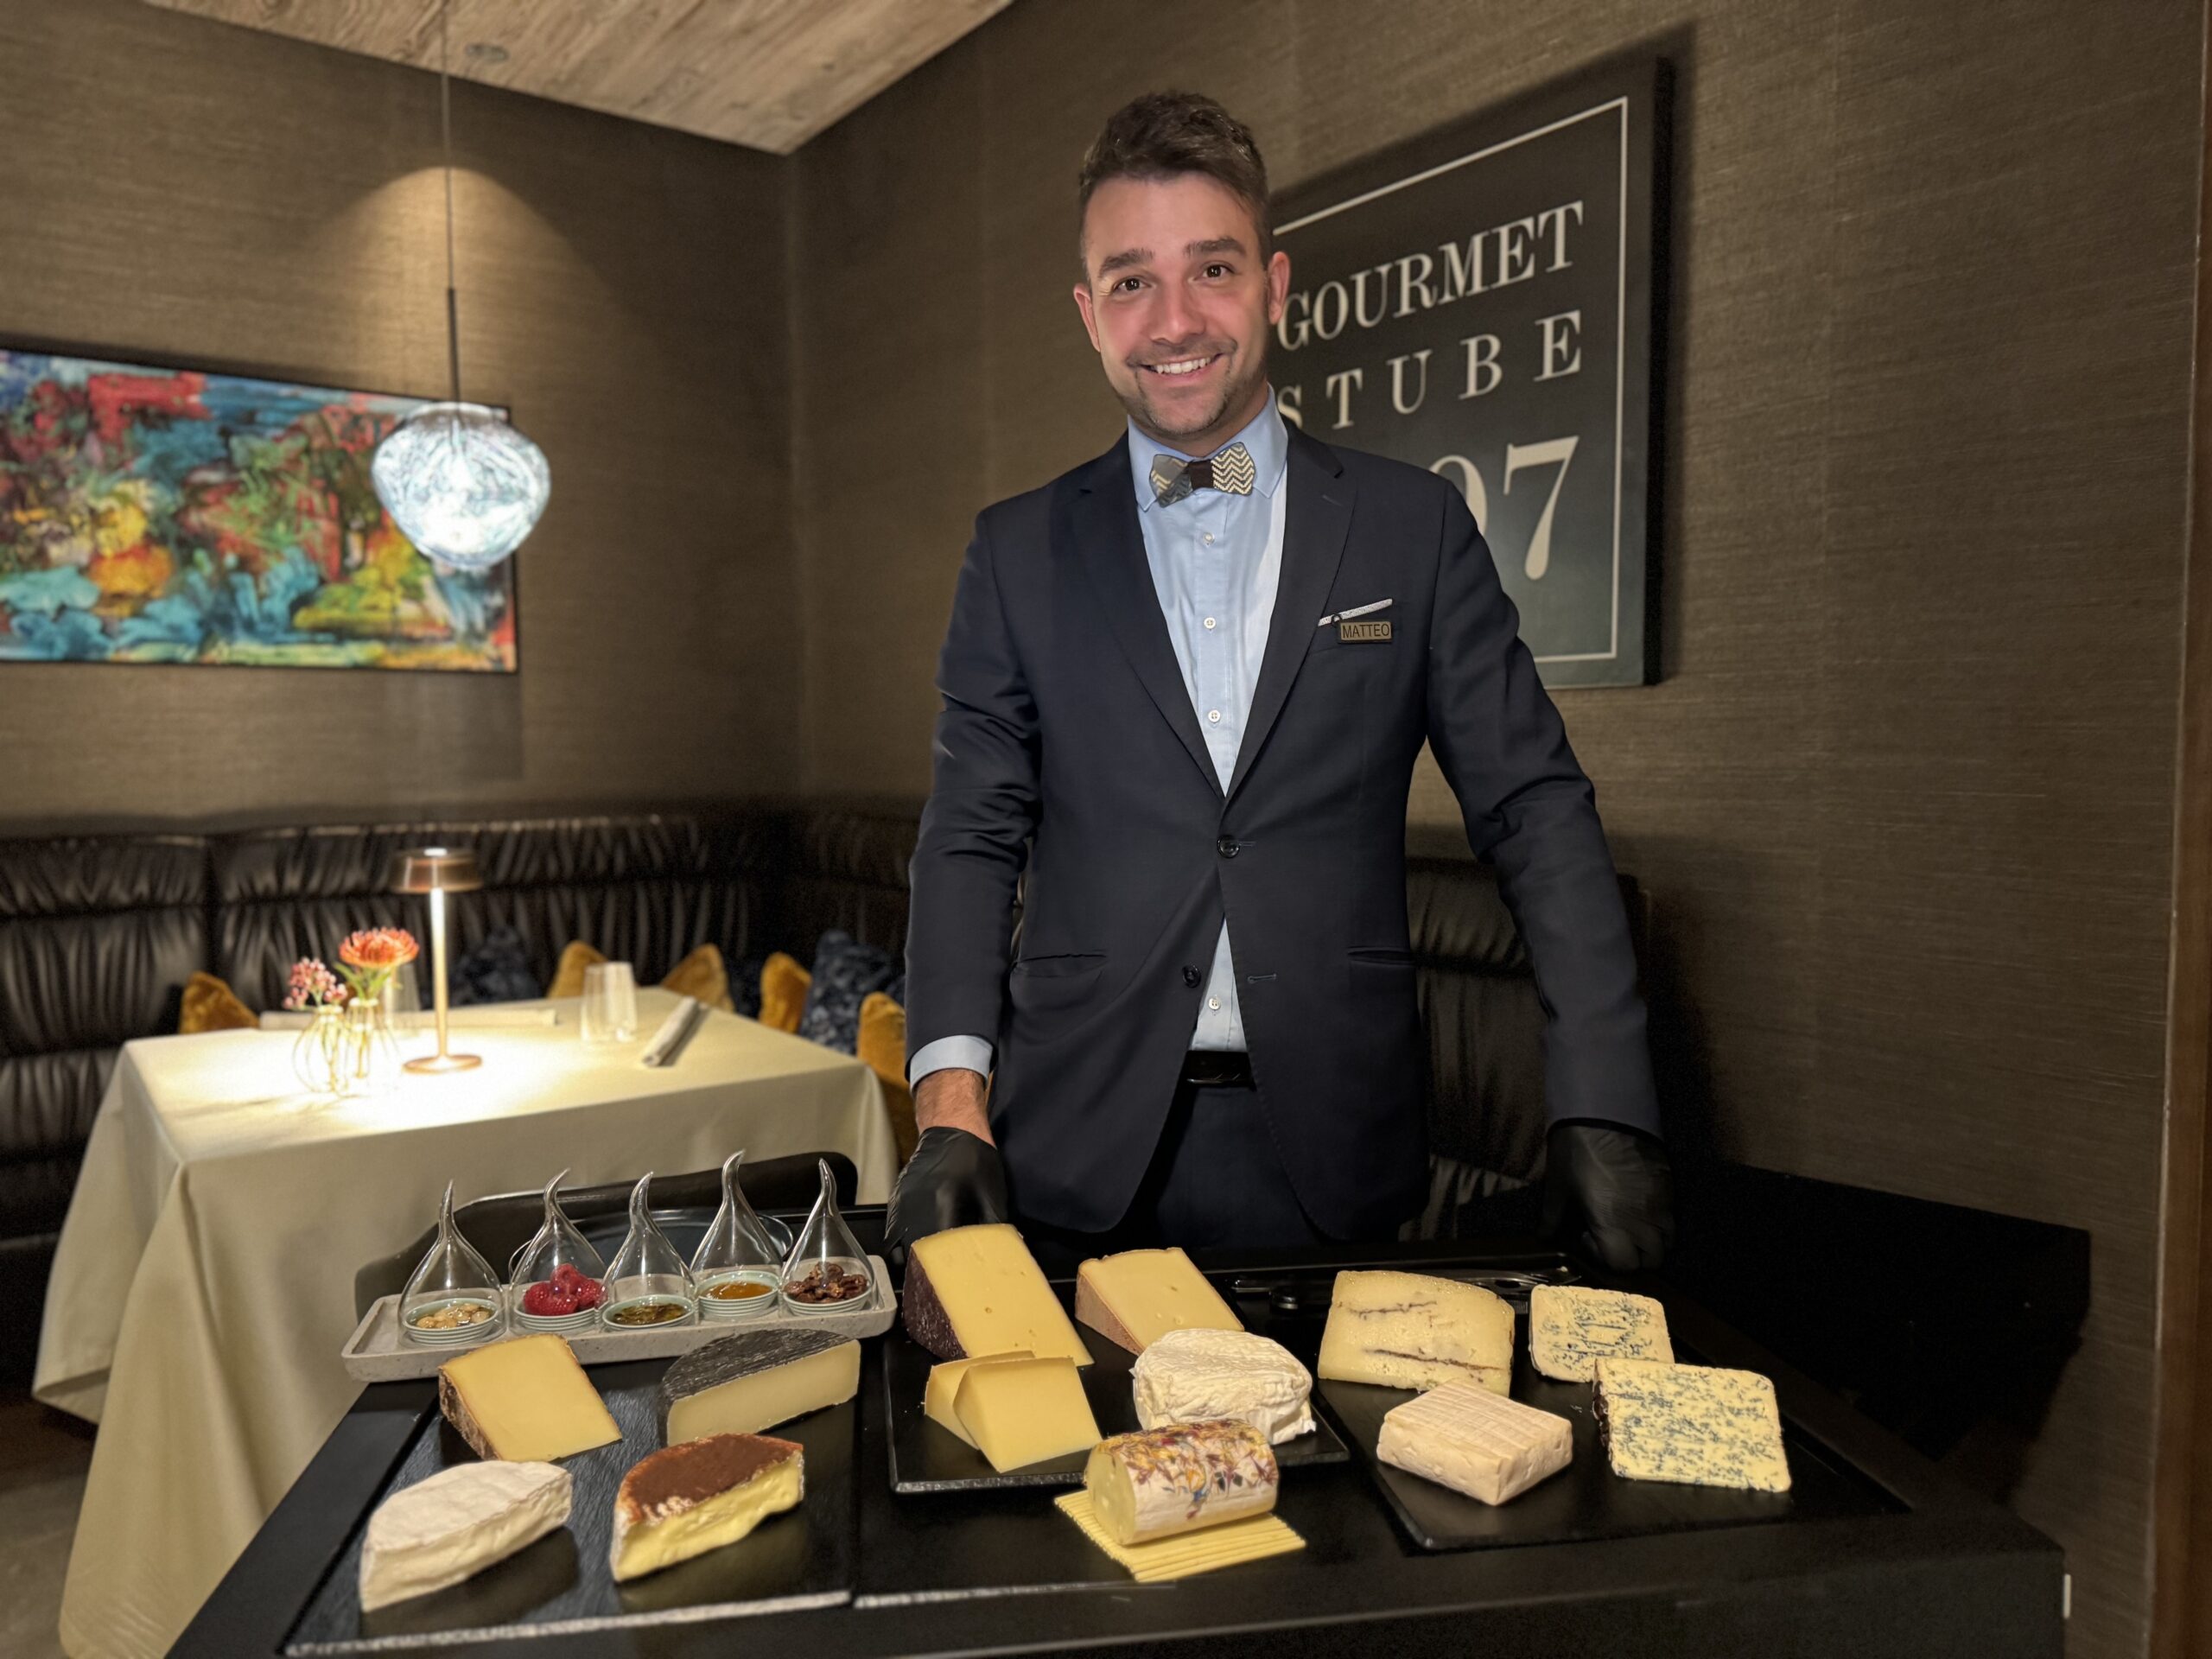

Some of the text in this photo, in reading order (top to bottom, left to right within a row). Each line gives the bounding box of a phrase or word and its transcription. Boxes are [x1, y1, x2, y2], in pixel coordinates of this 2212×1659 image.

[1276, 200, 1583, 350] GOURMET
[1277, 310, 1581, 429] STUBE
[1342, 623, 1389, 639] MATTEO
